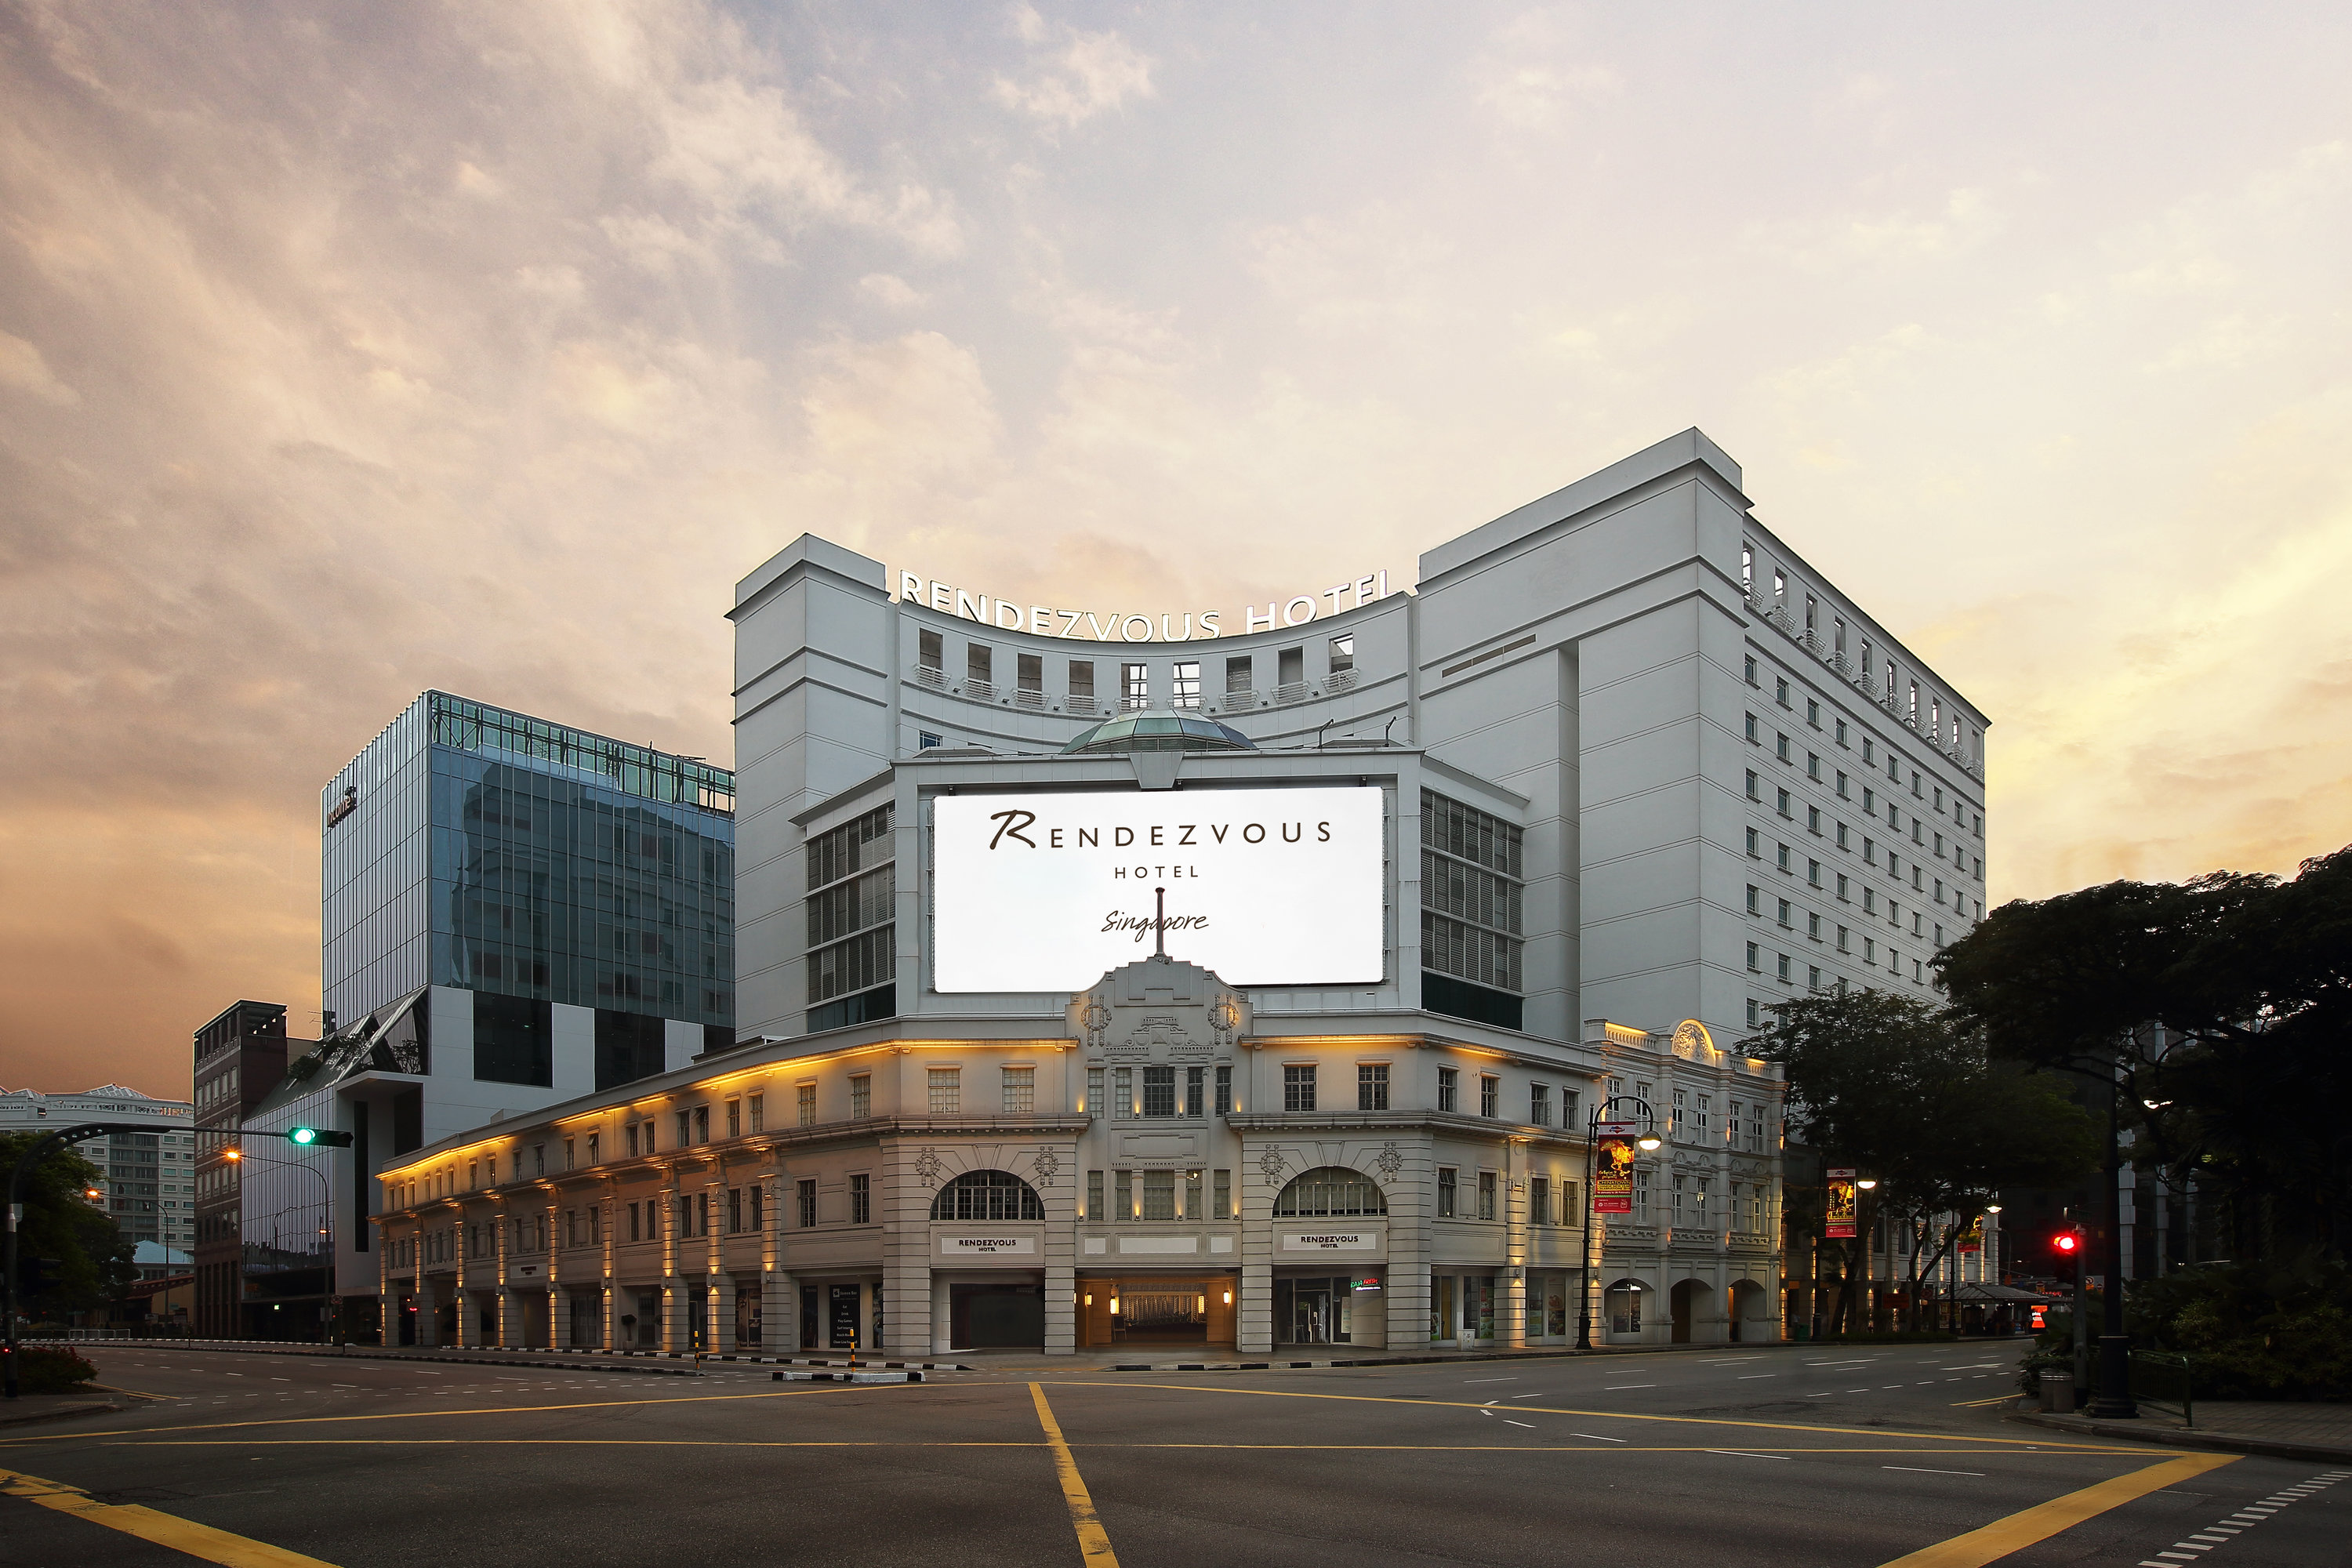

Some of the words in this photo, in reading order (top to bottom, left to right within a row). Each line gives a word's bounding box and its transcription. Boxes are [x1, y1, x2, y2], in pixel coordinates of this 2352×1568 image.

[899, 568, 1221, 643] RENDEZVOUS
[1246, 568, 1397, 634] HOTEL
[990, 810, 1330, 851] RENDEZVOUS
[1115, 865, 1199, 879] HOTEL
[1101, 910, 1210, 942] Singapore
[1350, 1279, 1363, 1288] BAJA
